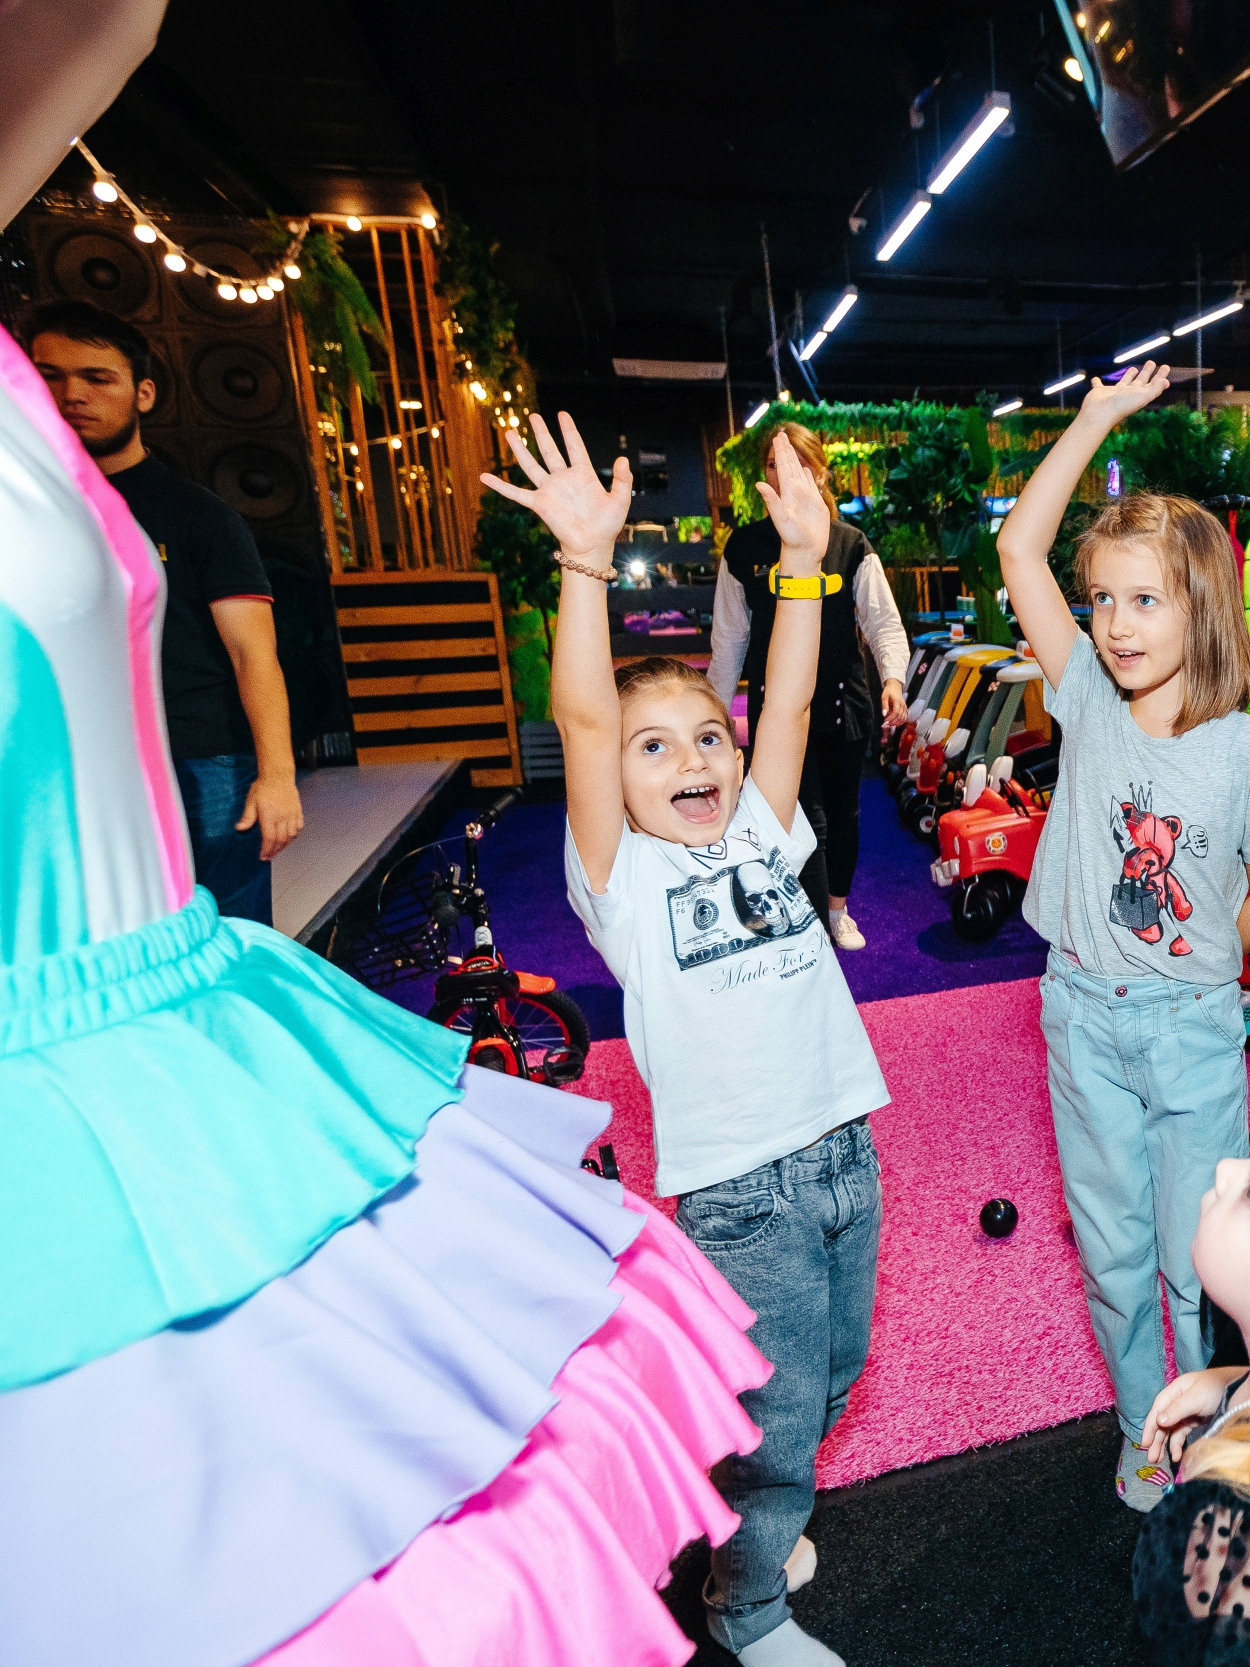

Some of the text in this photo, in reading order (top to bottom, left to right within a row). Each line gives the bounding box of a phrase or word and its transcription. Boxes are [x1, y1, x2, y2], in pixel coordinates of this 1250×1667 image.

[710, 959, 769, 995] Made
[772, 946, 804, 973] For
[779, 968, 800, 980] PHILIPP
